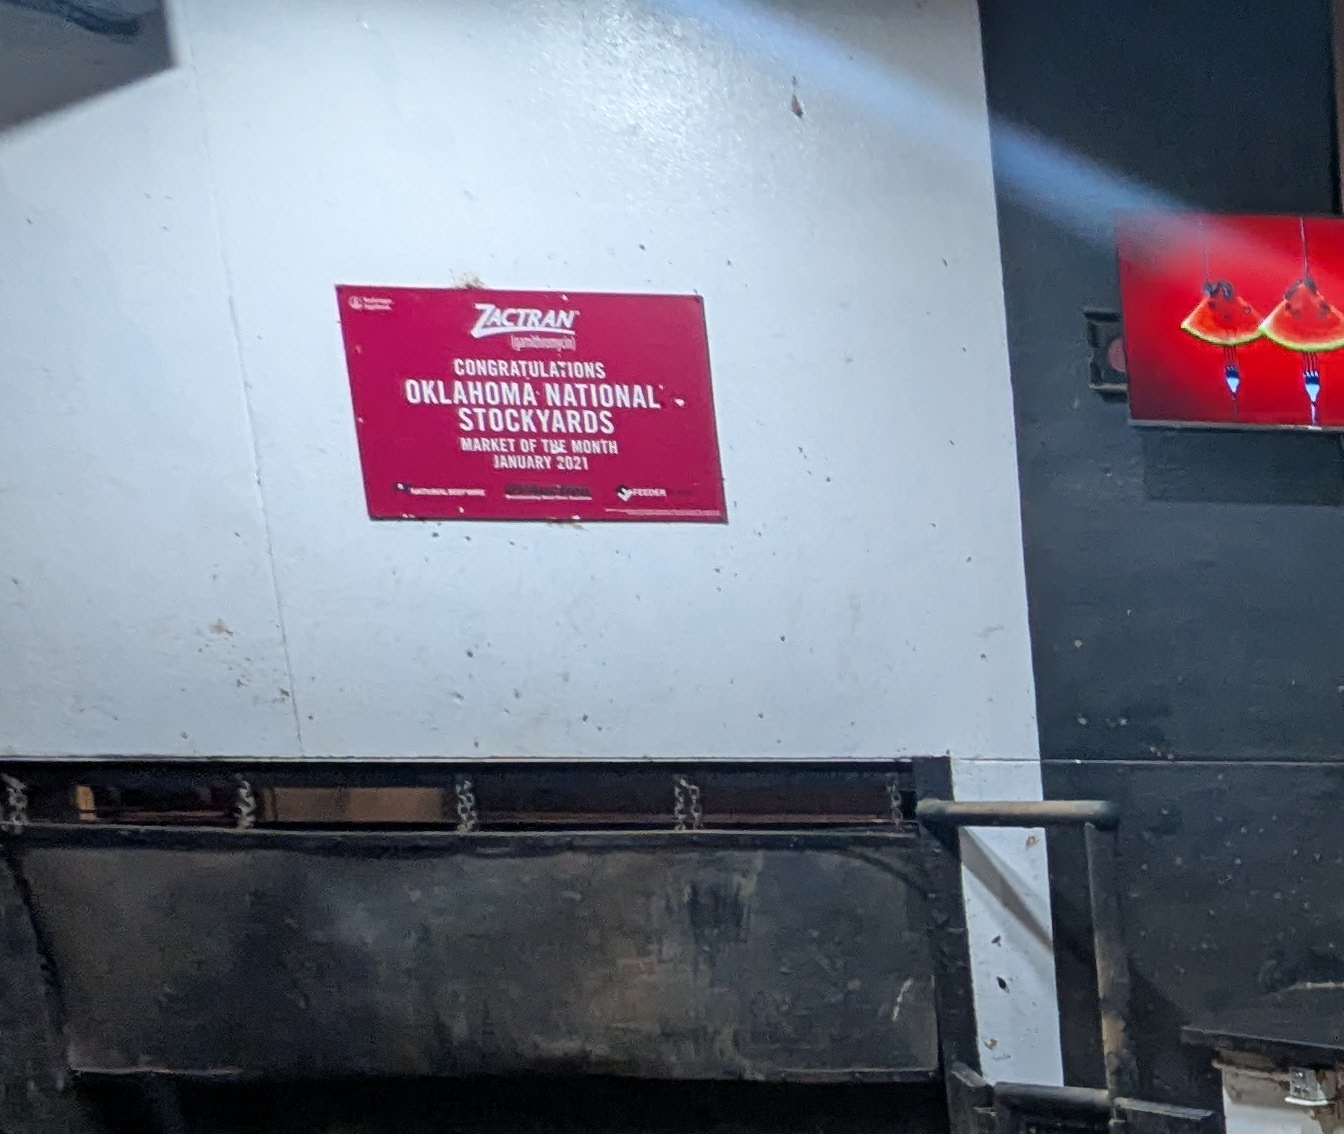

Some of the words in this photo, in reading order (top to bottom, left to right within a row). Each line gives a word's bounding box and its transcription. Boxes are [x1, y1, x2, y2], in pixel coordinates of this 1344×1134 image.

[470, 303, 577, 338] ZACTRAN
[453, 358, 606, 379] CONGRATULATIONS
[405, 379, 538, 407] OKLAHOMA
[544, 382, 662, 409] NATIONAL
[458, 407, 615, 434] STOCKYARDS
[460, 437, 515, 454] MARKET
[520, 438, 538, 453] OF
[543, 440, 567, 454] THE
[571, 440, 618, 455] MONTH
[493, 455, 552, 470] JANUARY
[557, 456, 589, 471] 2021
